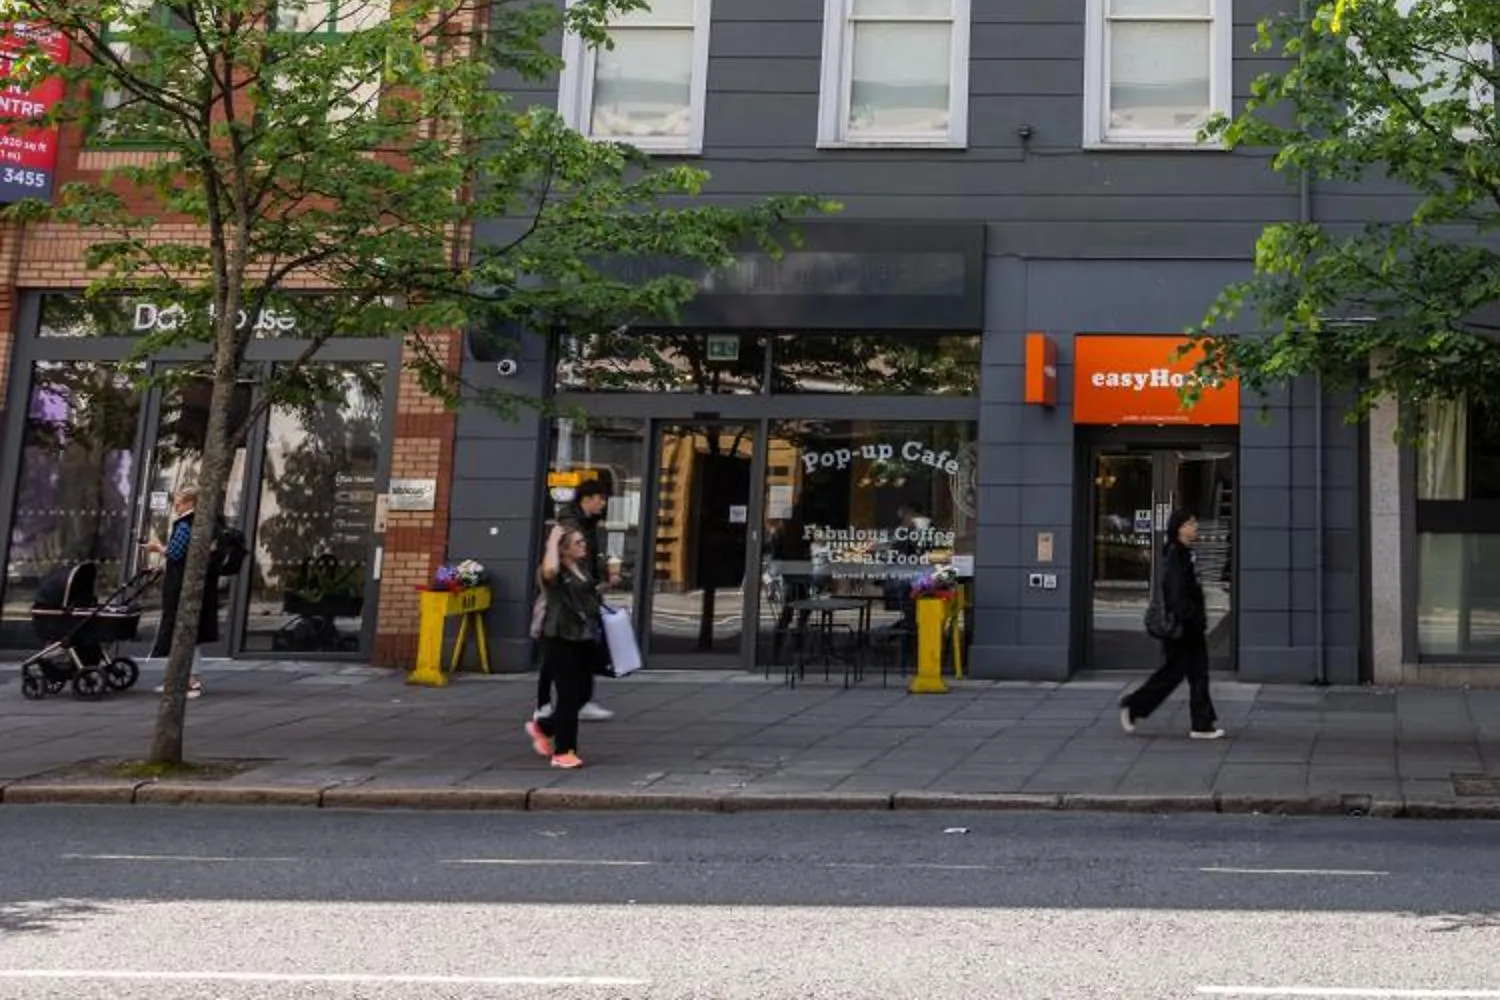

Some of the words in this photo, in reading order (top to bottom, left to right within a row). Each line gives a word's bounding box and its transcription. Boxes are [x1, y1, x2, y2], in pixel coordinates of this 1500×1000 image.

[3, 167, 46, 188] 3455
[802, 442, 893, 474] Pop-up
[901, 440, 960, 476] Cafe
[802, 524, 890, 542] Fabulous
[894, 526, 956, 544] Coffee
[827, 549, 886, 566] Great
[887, 549, 929, 566] Food
